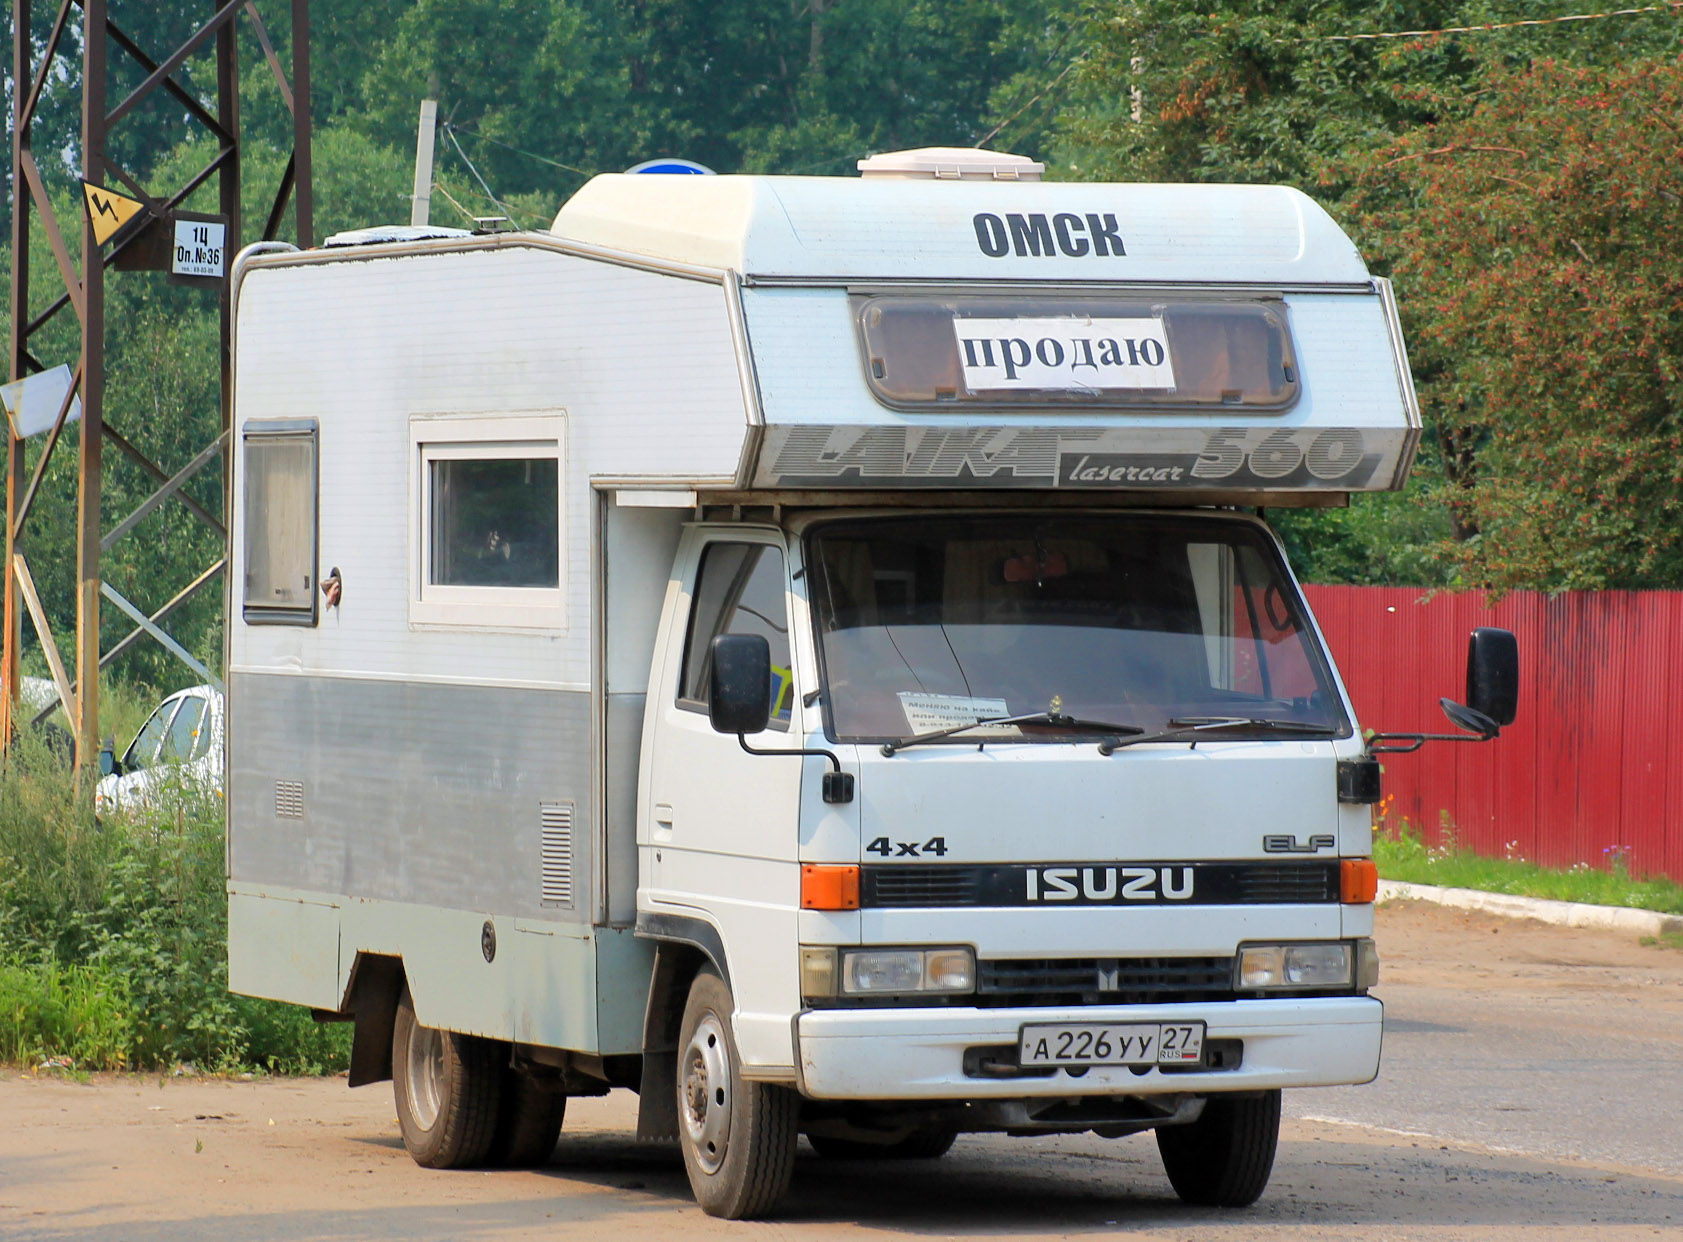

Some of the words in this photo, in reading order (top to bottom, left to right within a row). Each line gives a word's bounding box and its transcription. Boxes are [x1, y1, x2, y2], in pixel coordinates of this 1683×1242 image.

[973, 213, 1127, 257] ОМСК
[960, 338, 1165, 380] продаю
[770, 425, 1060, 477] LAIKA
[1069, 455, 1184, 481] lasercar
[1190, 427, 1364, 479] 560
[1263, 835, 1335, 853] ELF
[1026, 868, 1194, 900] ISUZU
[1162, 1027, 1193, 1050] 27
[1160, 1051, 1181, 1059] RUS
